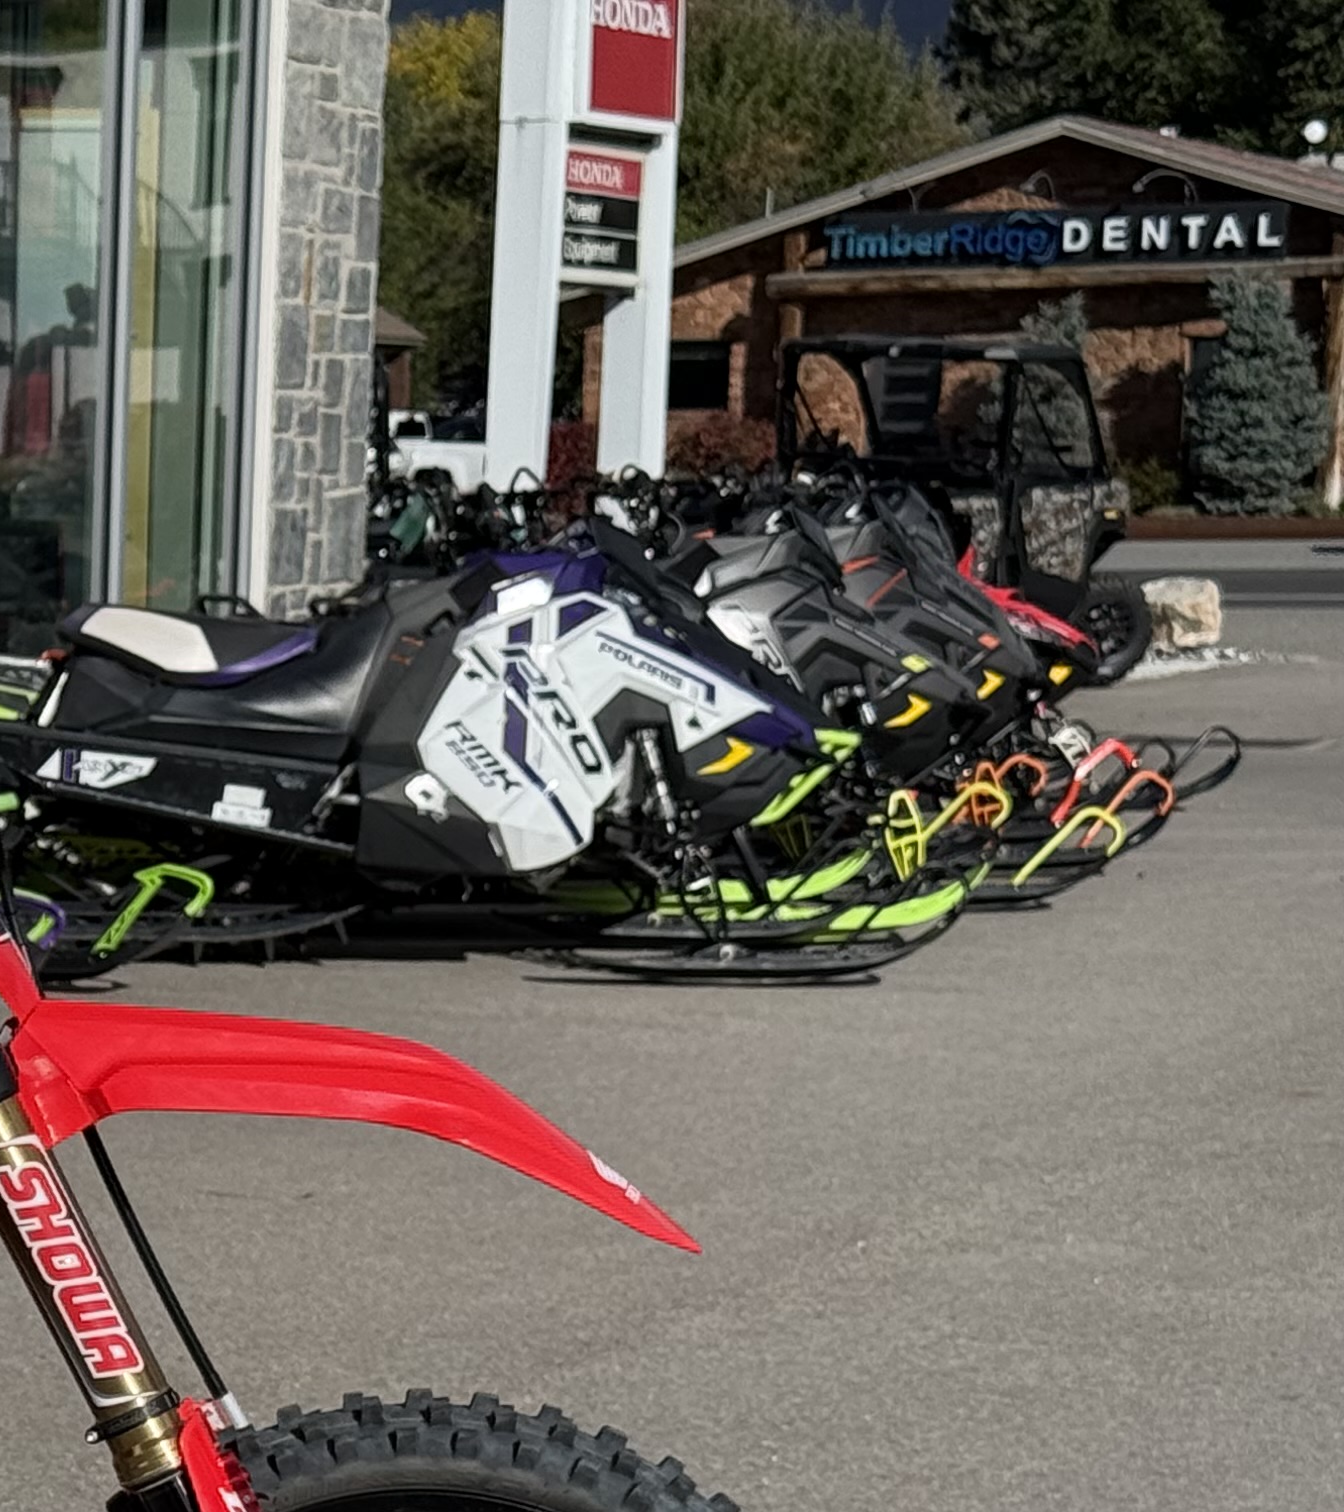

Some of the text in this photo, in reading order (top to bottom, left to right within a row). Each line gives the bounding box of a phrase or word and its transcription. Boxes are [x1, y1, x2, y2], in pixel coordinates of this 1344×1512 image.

[591, 0, 672, 39] HONDA
[568, 158, 624, 190] HONDA
[1063, 213, 1283, 254] DENTAL
[597, 641, 685, 690] POLARIS
[501, 646, 603, 775] PRO
[445, 719, 523, 796] RMK
